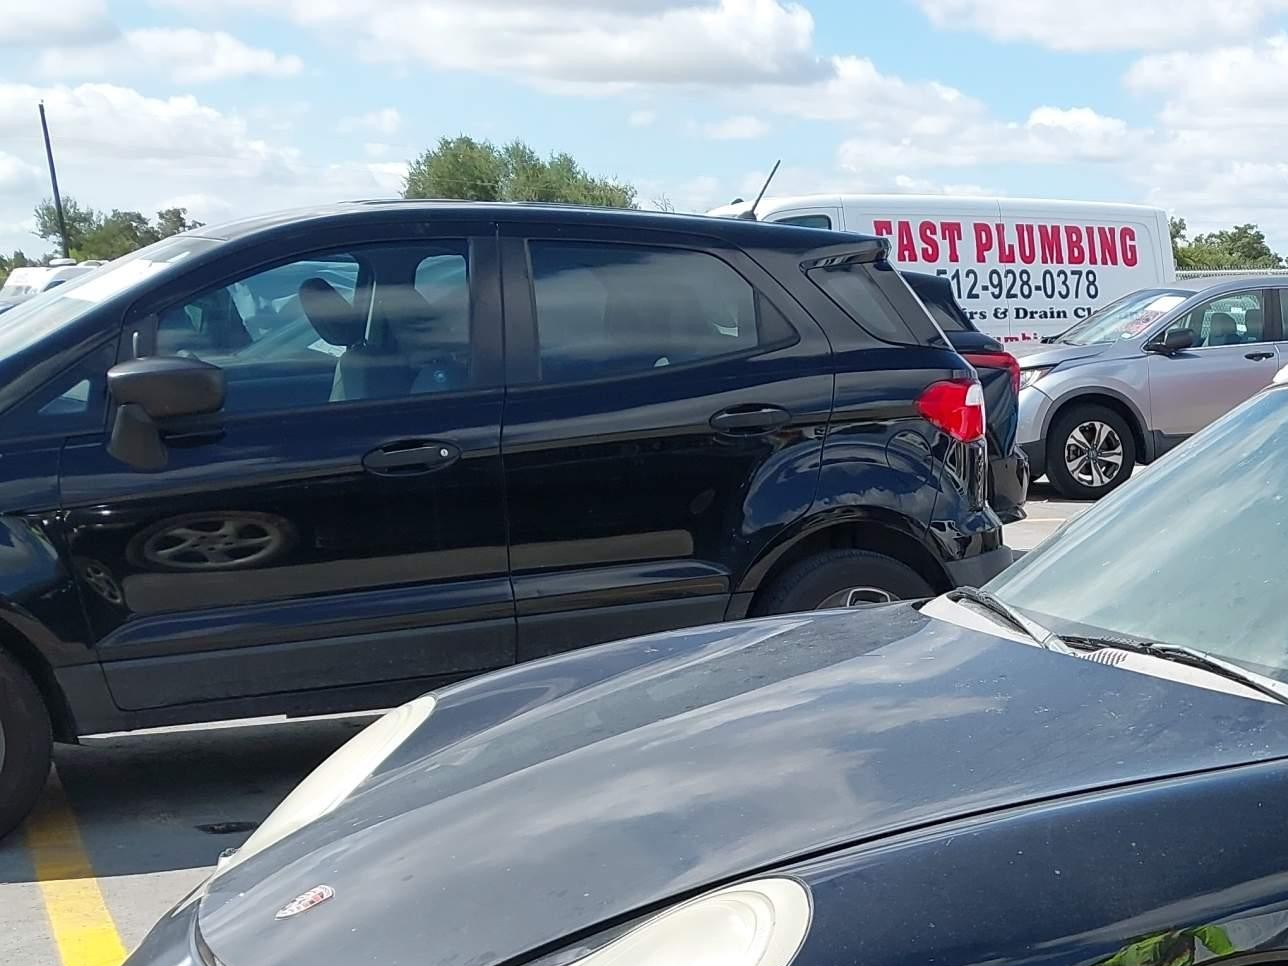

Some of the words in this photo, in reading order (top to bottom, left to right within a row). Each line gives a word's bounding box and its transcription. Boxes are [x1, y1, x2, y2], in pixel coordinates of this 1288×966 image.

[973, 222, 1138, 267] PLUMBING
[936, 268, 1099, 299] 12-928-0378
[993, 307, 1008, 319] &
[1014, 307, 1067, 319] Drain
